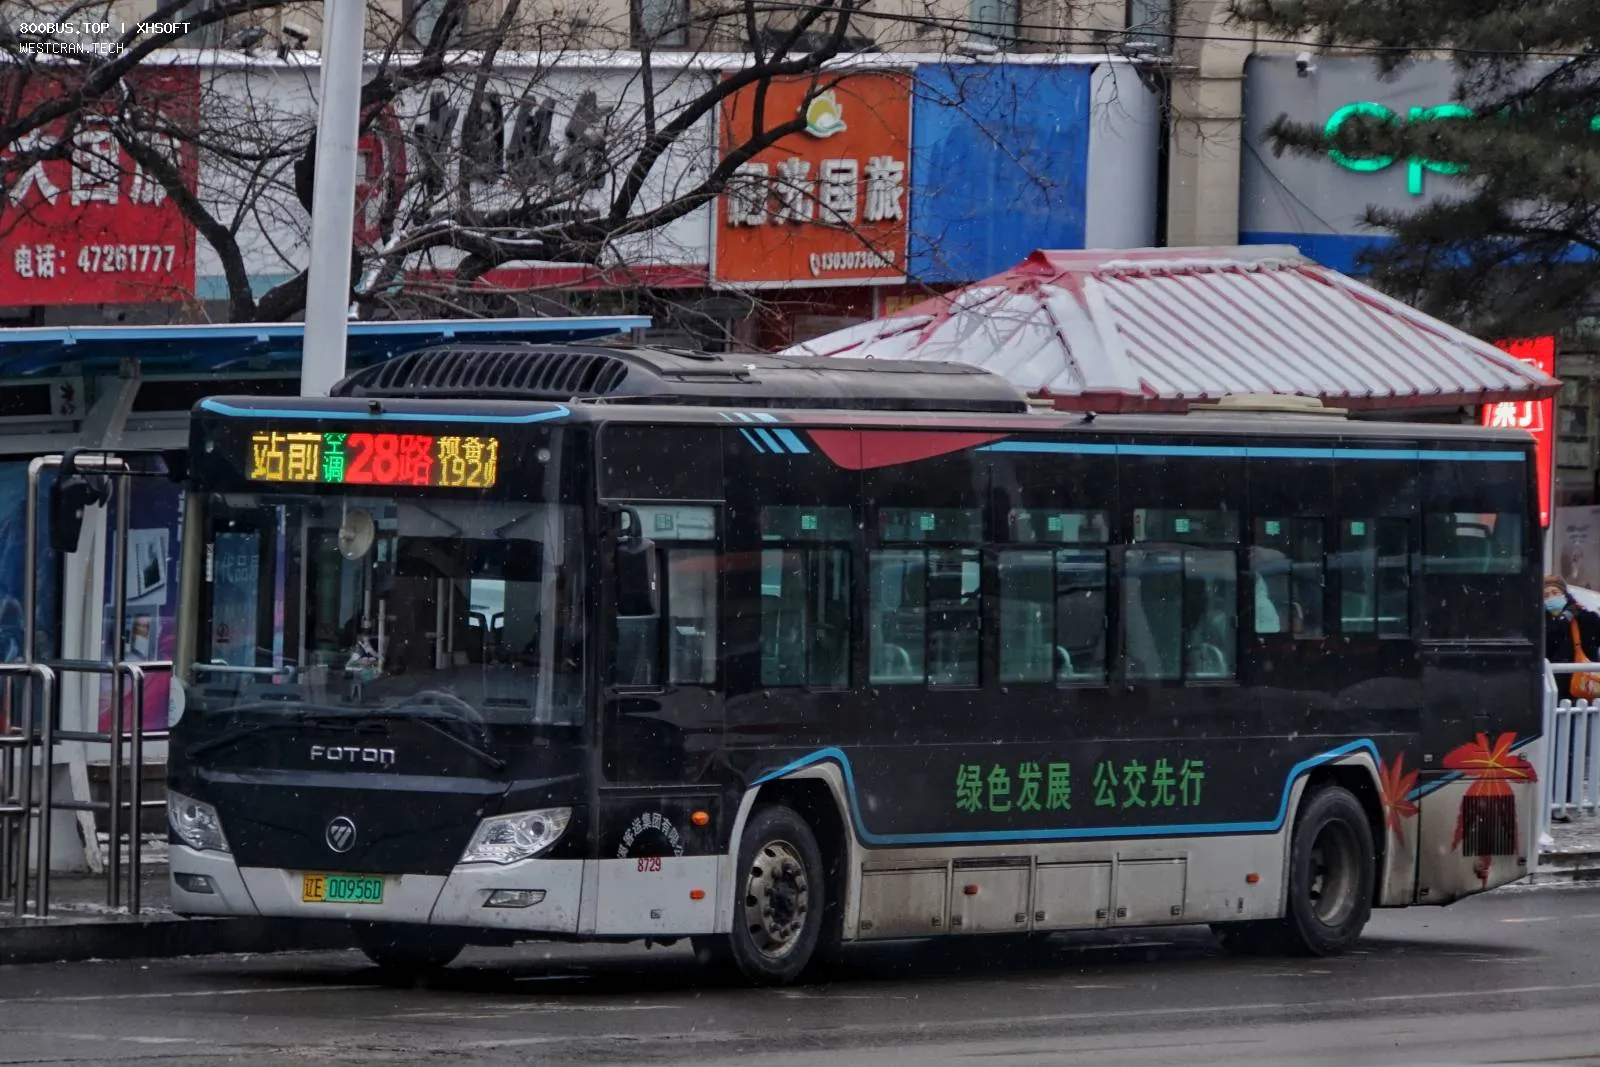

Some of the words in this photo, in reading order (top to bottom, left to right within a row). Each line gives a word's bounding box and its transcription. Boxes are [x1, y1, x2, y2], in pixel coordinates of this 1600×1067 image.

[77, 244, 176, 273] 47261777
[251, 431, 322, 481] 站前
[323, 433, 345, 482] 空调
[346, 432, 434, 486] 28路
[310, 745, 396, 764] FOTON
[955, 762, 1072, 812] 绿色发展
[1093, 757, 1205, 808] 公交先行
[637, 856, 661, 872] 8729
